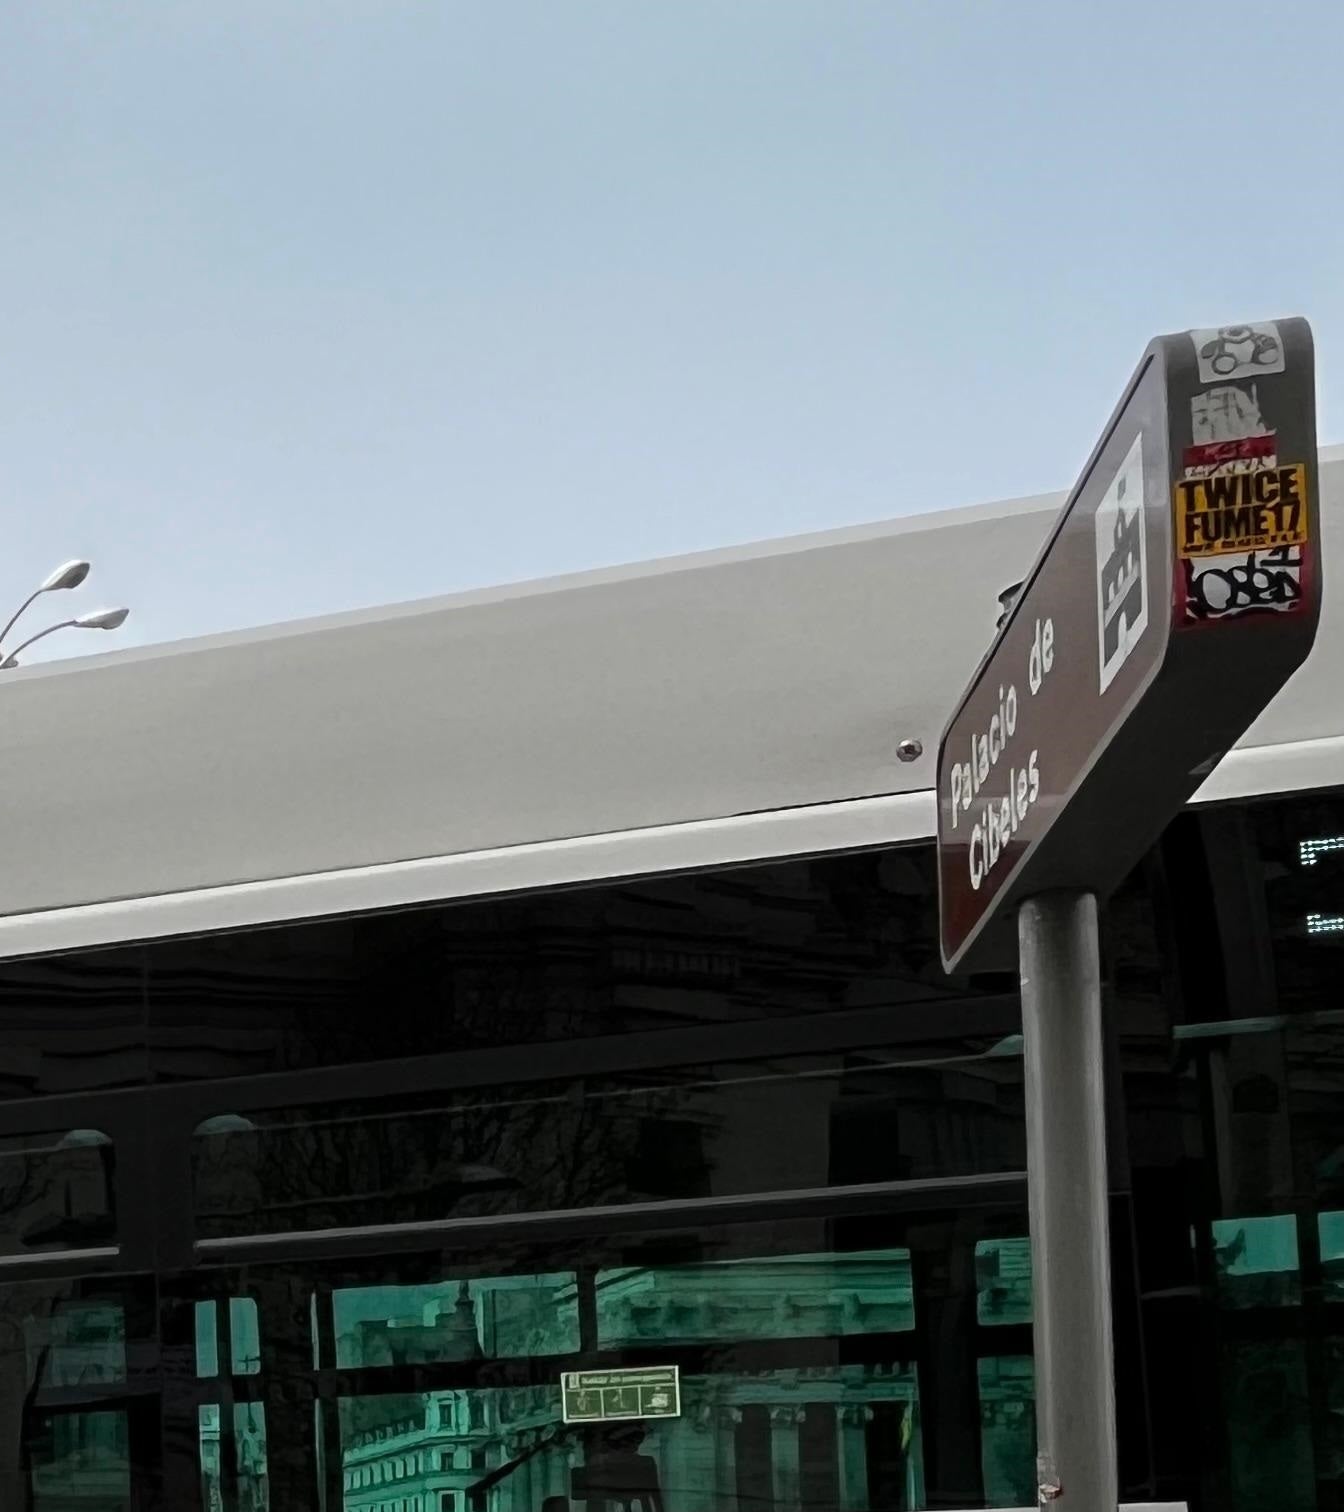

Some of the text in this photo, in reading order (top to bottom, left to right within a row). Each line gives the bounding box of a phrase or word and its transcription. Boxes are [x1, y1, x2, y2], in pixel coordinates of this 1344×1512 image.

[1178, 468, 1299, 512] TWICE
[950, 617, 1054, 830] Palacio de
[968, 749, 1040, 891] Cibeles
